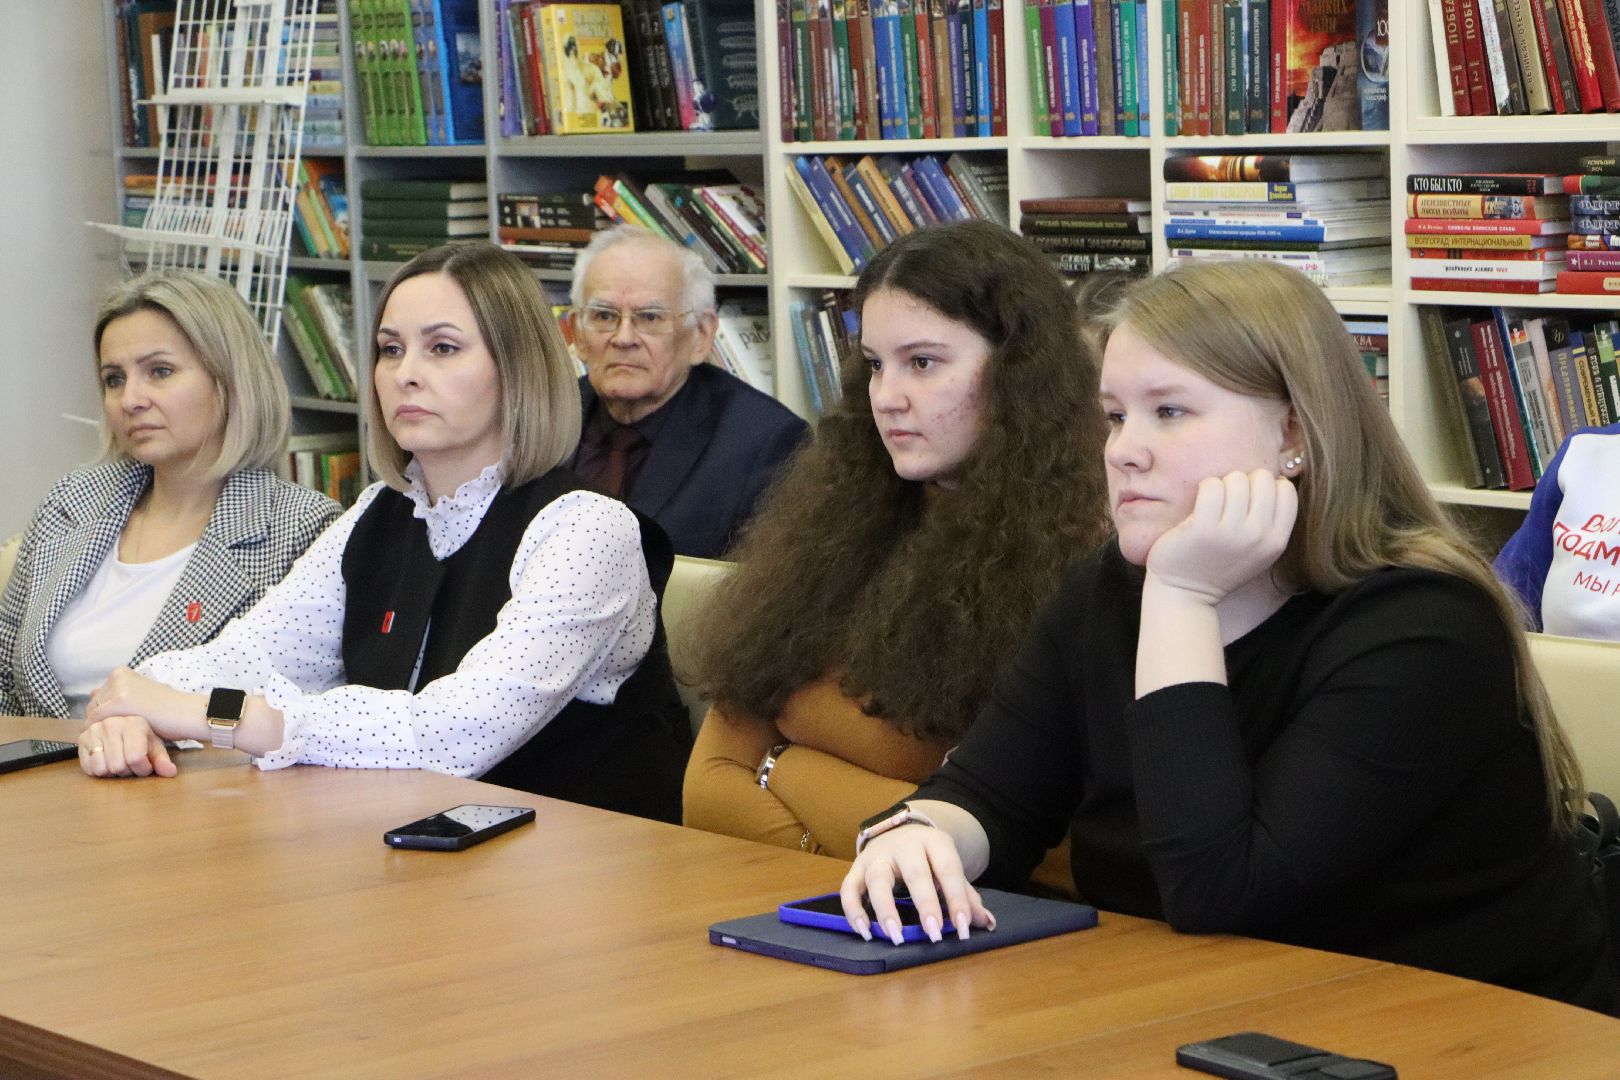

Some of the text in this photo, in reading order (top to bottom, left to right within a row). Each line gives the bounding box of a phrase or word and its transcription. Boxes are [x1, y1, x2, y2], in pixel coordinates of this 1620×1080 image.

[1376, 20, 1389, 37] 10
[1462, 0, 1476, 40] ПОБЕ
[1519, 40, 1533, 84] ВЕЛИКАЯ
[1472, 70, 1480, 82] 2
[1414, 179, 1429, 191] КТО
[1430, 179, 1447, 191] БЫЛ
[1447, 179, 1462, 191] КТО
[1414, 236, 1523, 247] ВОЛГОГРАД ИНТЕРНАЦИОНАЛЬНЫЙ
[1553, 521, 1620, 566] ПОДМ
[1573, 571, 1611, 595] МЫ
